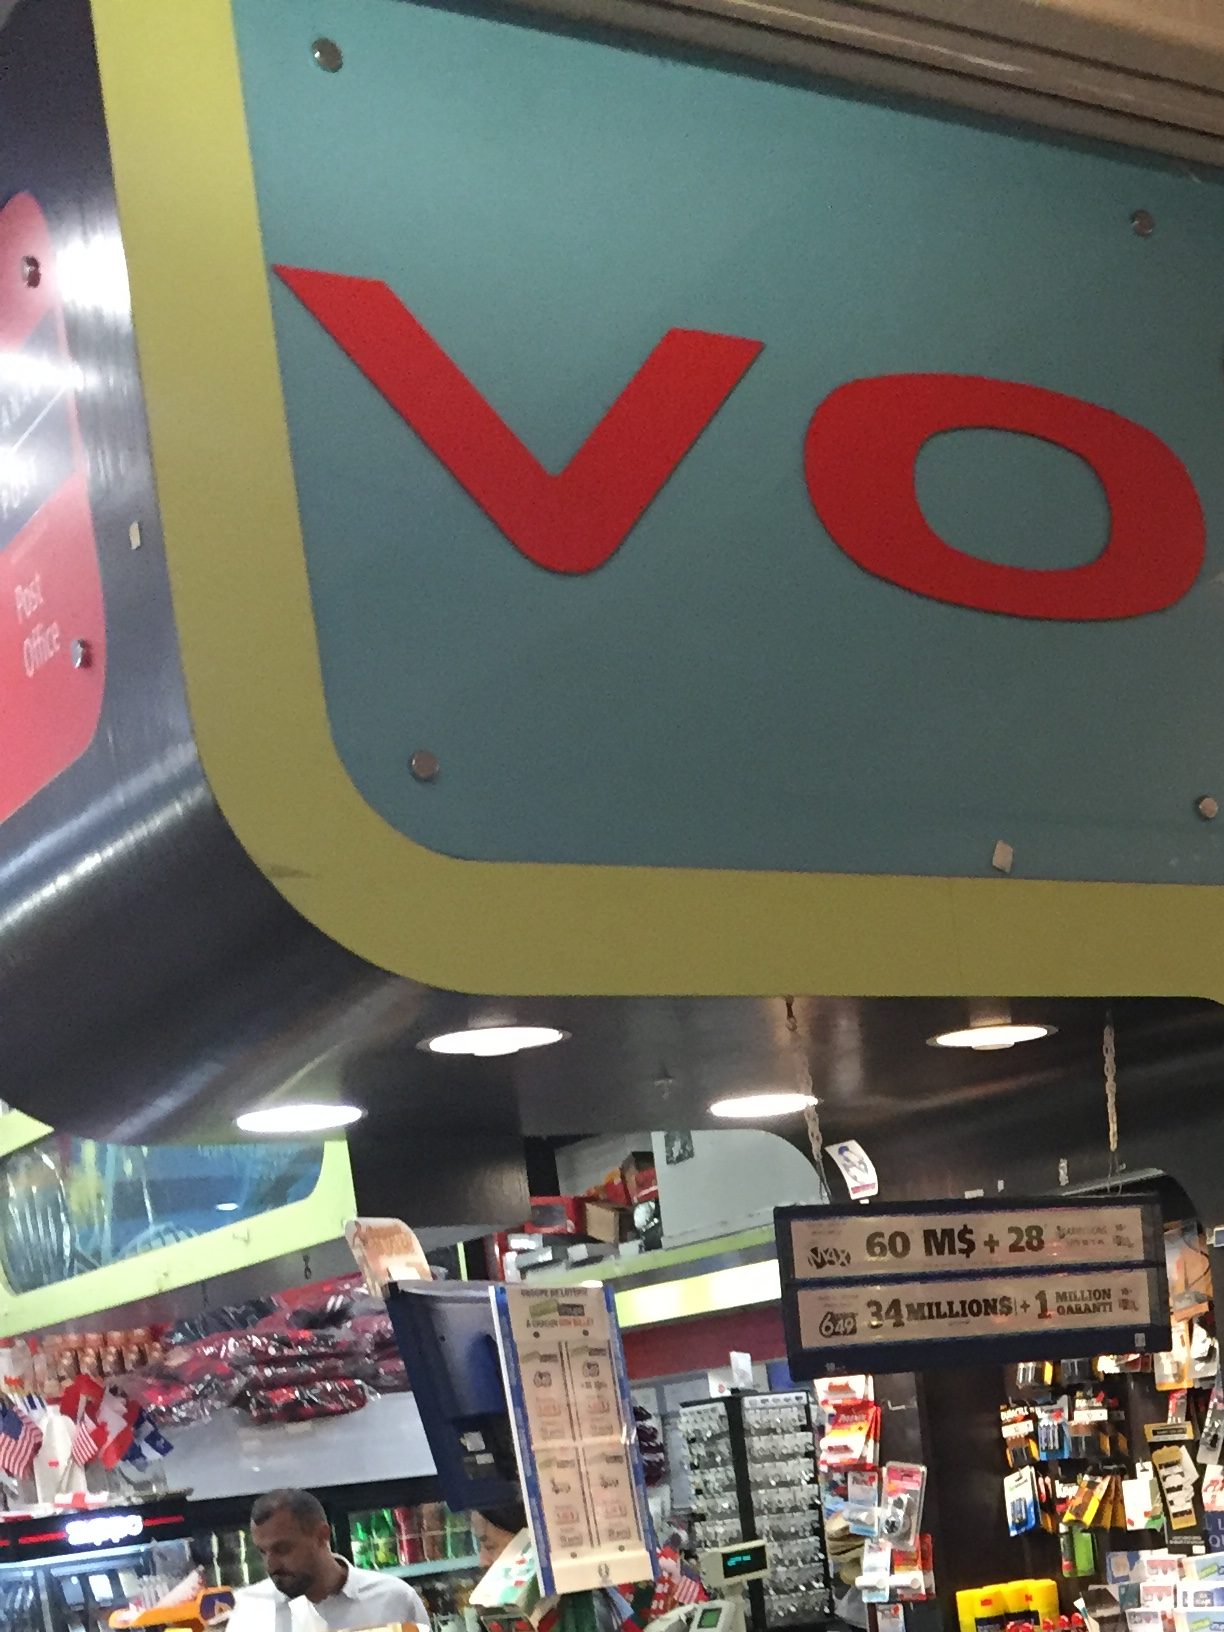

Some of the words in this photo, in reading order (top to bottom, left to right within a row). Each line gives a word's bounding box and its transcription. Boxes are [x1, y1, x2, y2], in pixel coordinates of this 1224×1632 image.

[23, 622, 60, 678] Office
[866, 1231, 911, 1259] 60
[923, 1214, 976, 1258] M$
[1008, 1225, 1045, 1253] 28
[867, 1299, 905, 1328] 34
[1056, 1288, 1112, 1303] MILLION
